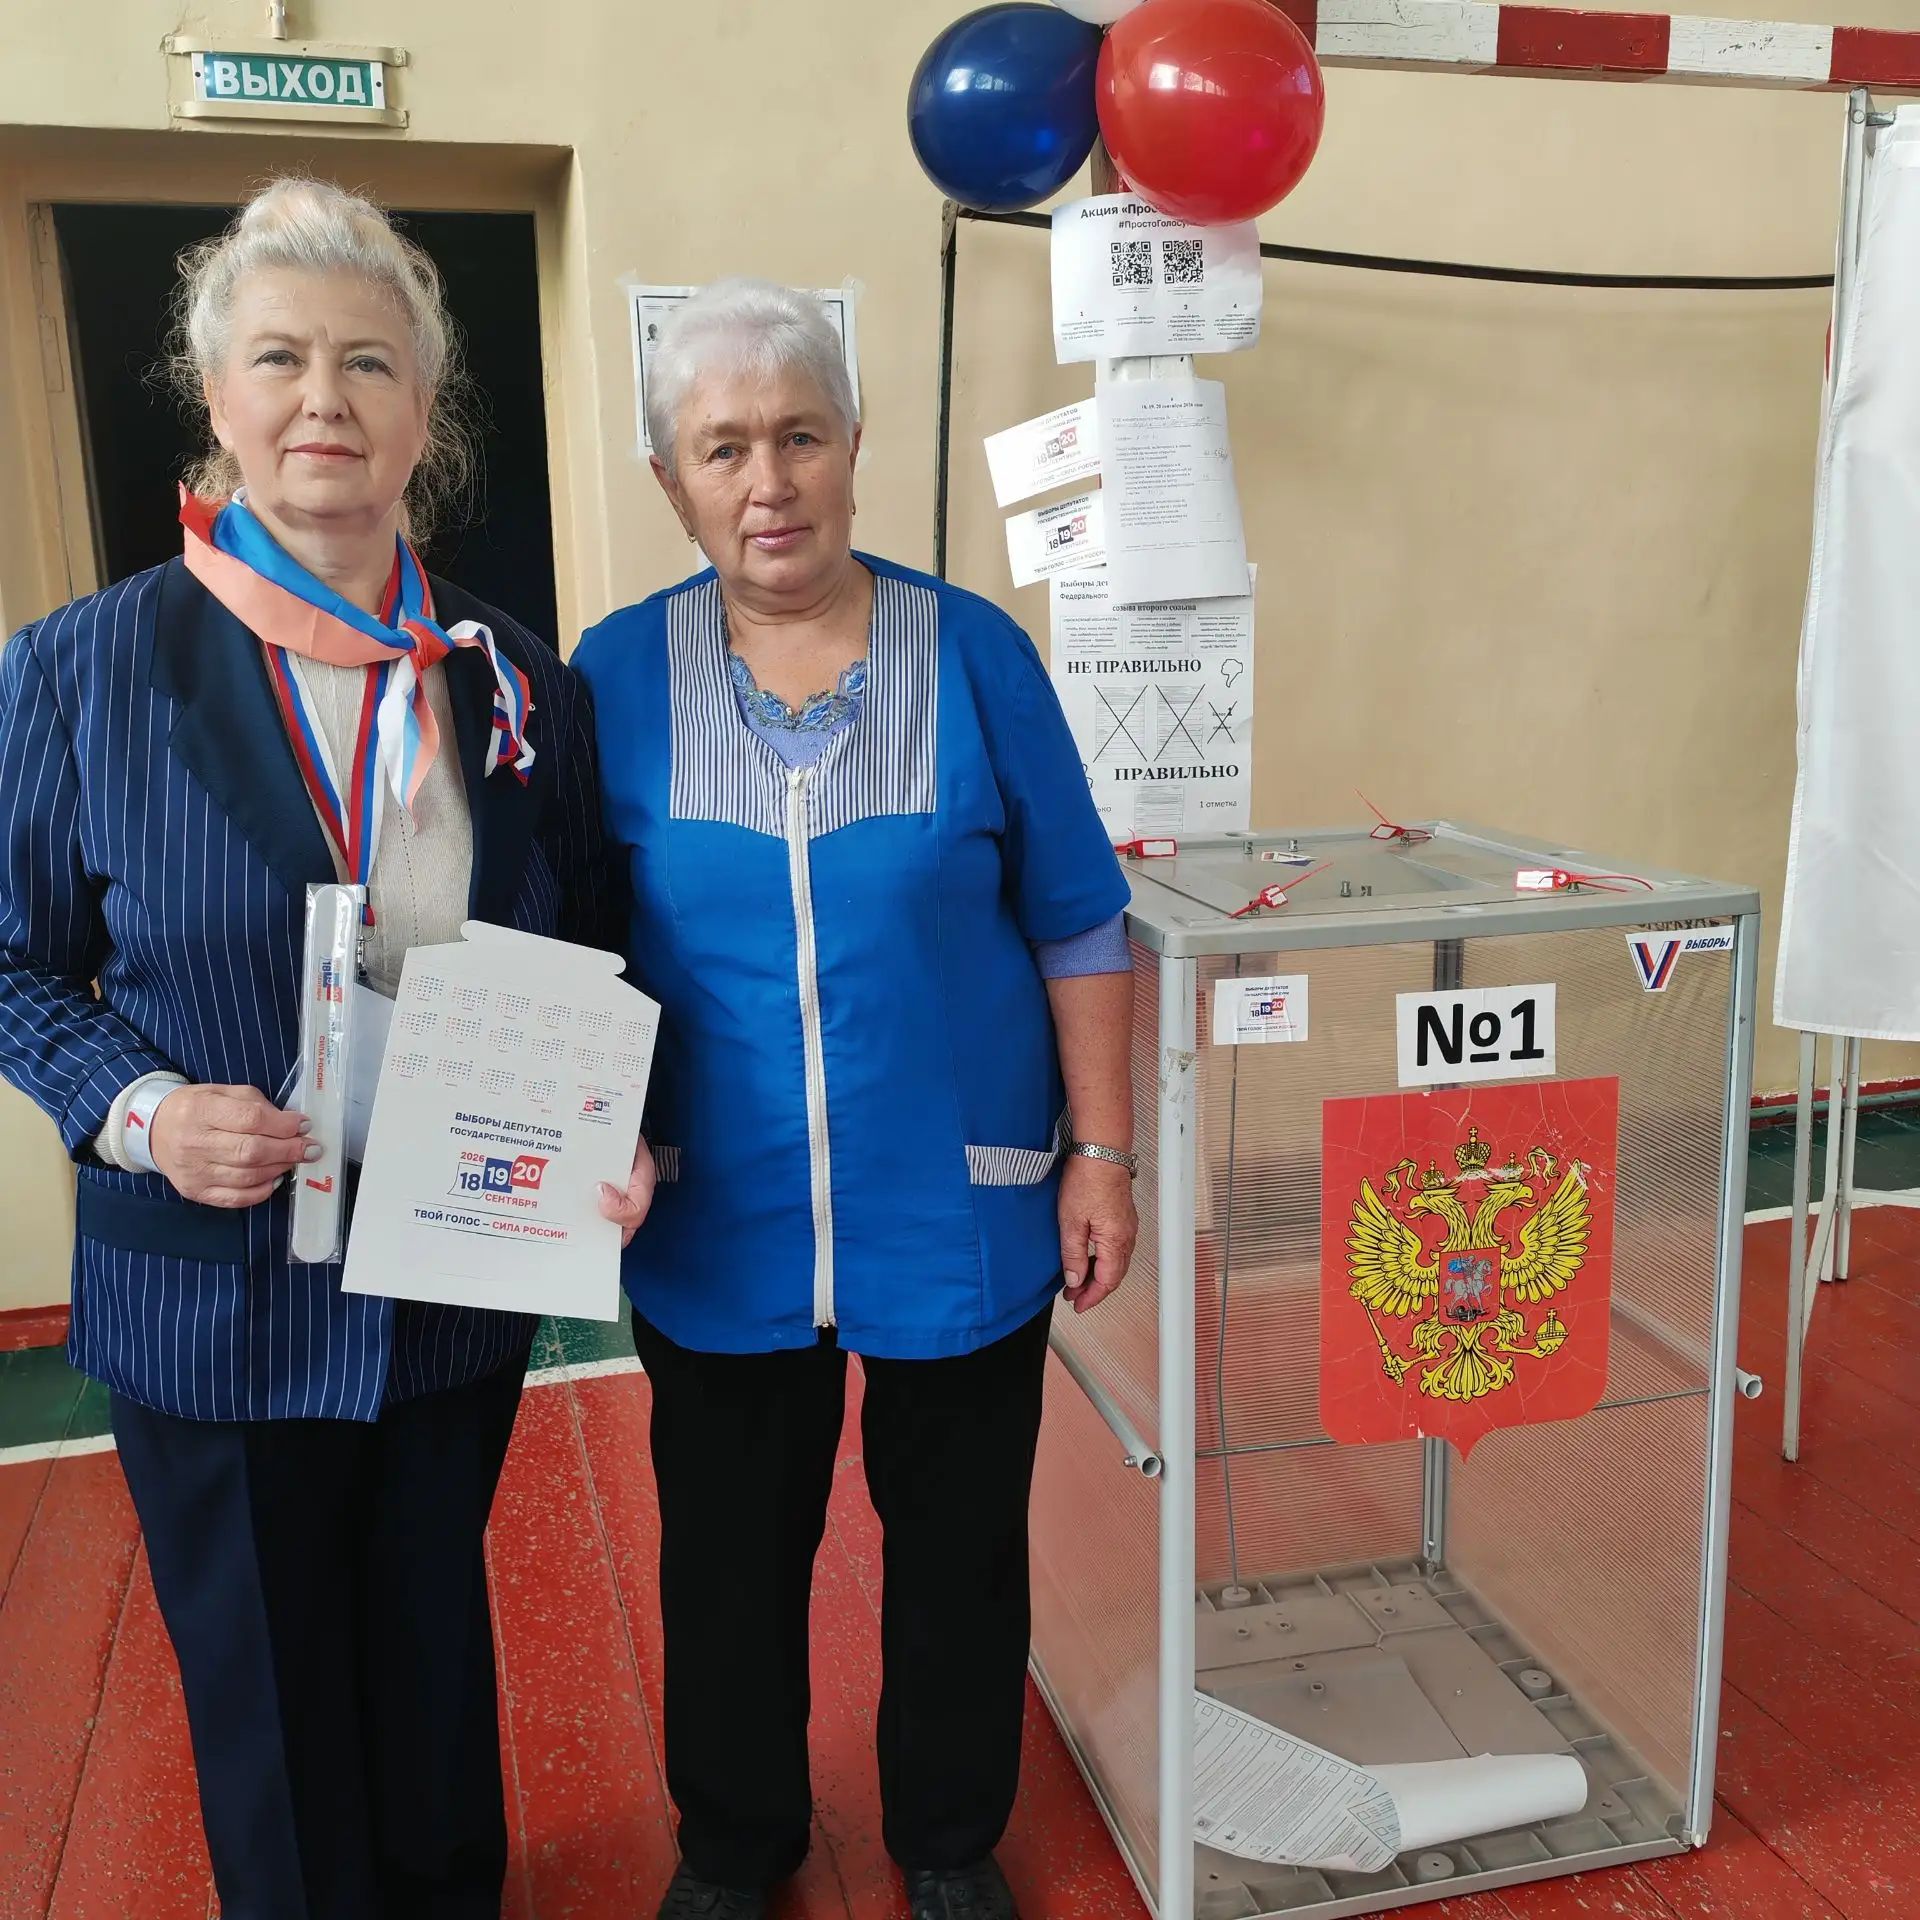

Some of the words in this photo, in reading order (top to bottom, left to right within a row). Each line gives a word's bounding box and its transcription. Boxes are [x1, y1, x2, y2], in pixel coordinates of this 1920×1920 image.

[213, 60, 366, 104] ВЫХОД
[1081, 206, 1118, 218] Акция
[1121, 203, 1158, 216] «Прос
[1119, 219, 1188, 230] #ПростоГолосу
[1047, 442, 1059, 454] 19
[1061, 433, 1076, 445] 20
[1048, 538, 1059, 550] 18
[1059, 528, 1070, 541] 19
[1071, 519, 1085, 531] 20
[1060, 580, 1094, 588] Выборы
[1112, 604, 1136, 612] созыва
[1138, 604, 1167, 613] второго
[1169, 603, 1197, 611] созыва
[1067, 661, 1091, 673] НЕ
[1096, 659, 1202, 674] ПРАВИЛЬНО
[1114, 764, 1239, 781] ПРАВИЛЬНО
[1200, 800, 1204, 808] 1
[1206, 800, 1237, 808] отметка
[1685, 937, 1731, 950] ВЫБОРЫ
[322, 960, 332, 972] 18
[1251, 1009, 1260, 1018] 18
[1261, 1005, 1270, 1013] 19
[1272, 1000, 1283, 1009] 20
[1416, 999, 1545, 1067] №1
[318, 1035, 326, 1056] СИЛА
[455, 1112, 501, 1128] ВЫБОРЫ
[503, 1121, 563, 1139] ДЕПУТАТОВ
[450, 1126, 534, 1148] ГОСУДАРСТВЕННОЙ
[535, 1142, 562, 1153] ДУМЫ
[460, 1151, 485, 1163] 2026
[459, 1171, 481, 1191] 18
[487, 1166, 508, 1186] 19
[512, 1162, 541, 1182] 20
[485, 1193, 538, 1209] СЕНТЯБРЯ
[414, 1208, 443, 1221] ТВОЙ
[445, 1214, 481, 1227] ГОЛОС
[492, 1221, 521, 1233] СИЛА
[523, 1226, 568, 1239] РОССИИ!
